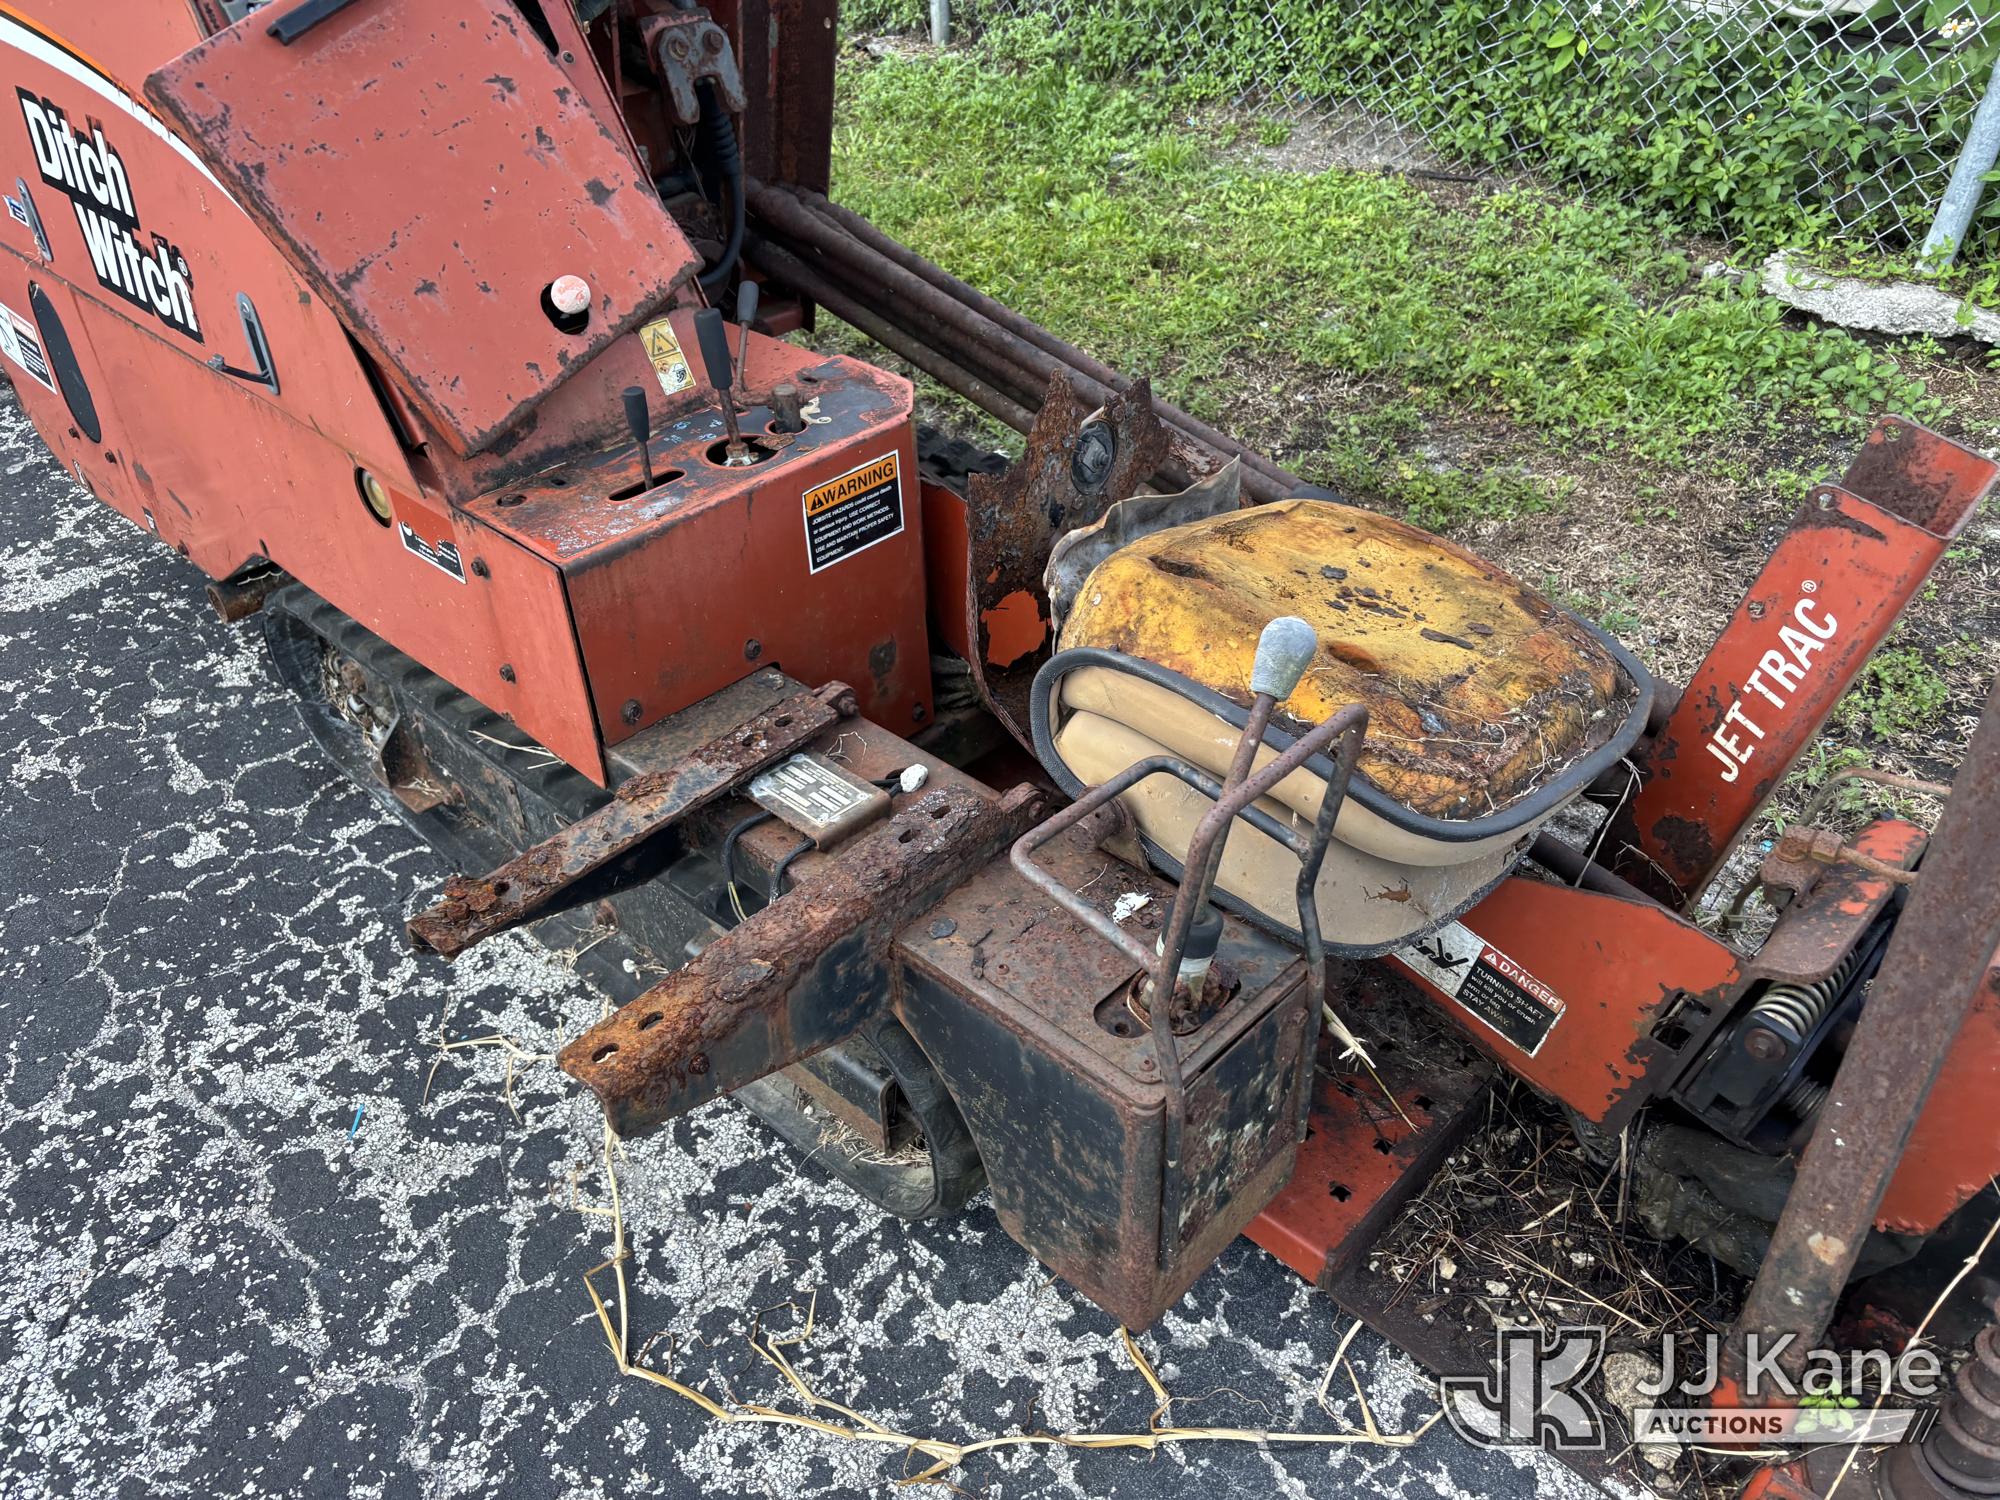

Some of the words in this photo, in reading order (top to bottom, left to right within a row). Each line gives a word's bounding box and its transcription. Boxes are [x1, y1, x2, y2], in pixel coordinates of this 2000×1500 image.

[22, 98, 134, 217] Ditch
[812, 513, 832, 525] JOBSITE
[832, 502, 854, 516] HAZARDS
[855, 497, 866, 507] could
[867, 491, 880, 500] cause
[880, 485, 892, 496] death
[822, 462, 894, 506] WARNING
[814, 528, 841, 544] EQUIPMENT
[842, 522, 852, 532] AND
[852, 516, 866, 527] WORK
[815, 544, 825, 554] USE
[826, 540, 837, 549] AND
[837, 530, 859, 543] MAINTAIN
[859, 520, 877, 533] PROPER
[877, 512, 894, 525] SAFETY
[819, 522, 835, 533] serious
[849, 509, 859, 518] USE
[859, 499, 881, 514] CORRECT
[1705, 700, 1766, 783] JET
[1462, 989, 1485, 1007] STAY
[1466, 982, 1480, 995] arm
[1480, 992, 1489, 1001] or
[1471, 975, 1483, 986] will
[1483, 982, 1494, 994] kill
[1494, 992, 1507, 1005] you
[1507, 1002, 1516, 1011] or
[1516, 1008, 1536, 1025] crush
[1476, 966, 1515, 998] TURNING
[1516, 996, 1545, 1020] SHAFT
[1499, 961, 1561, 1010] DANGER
